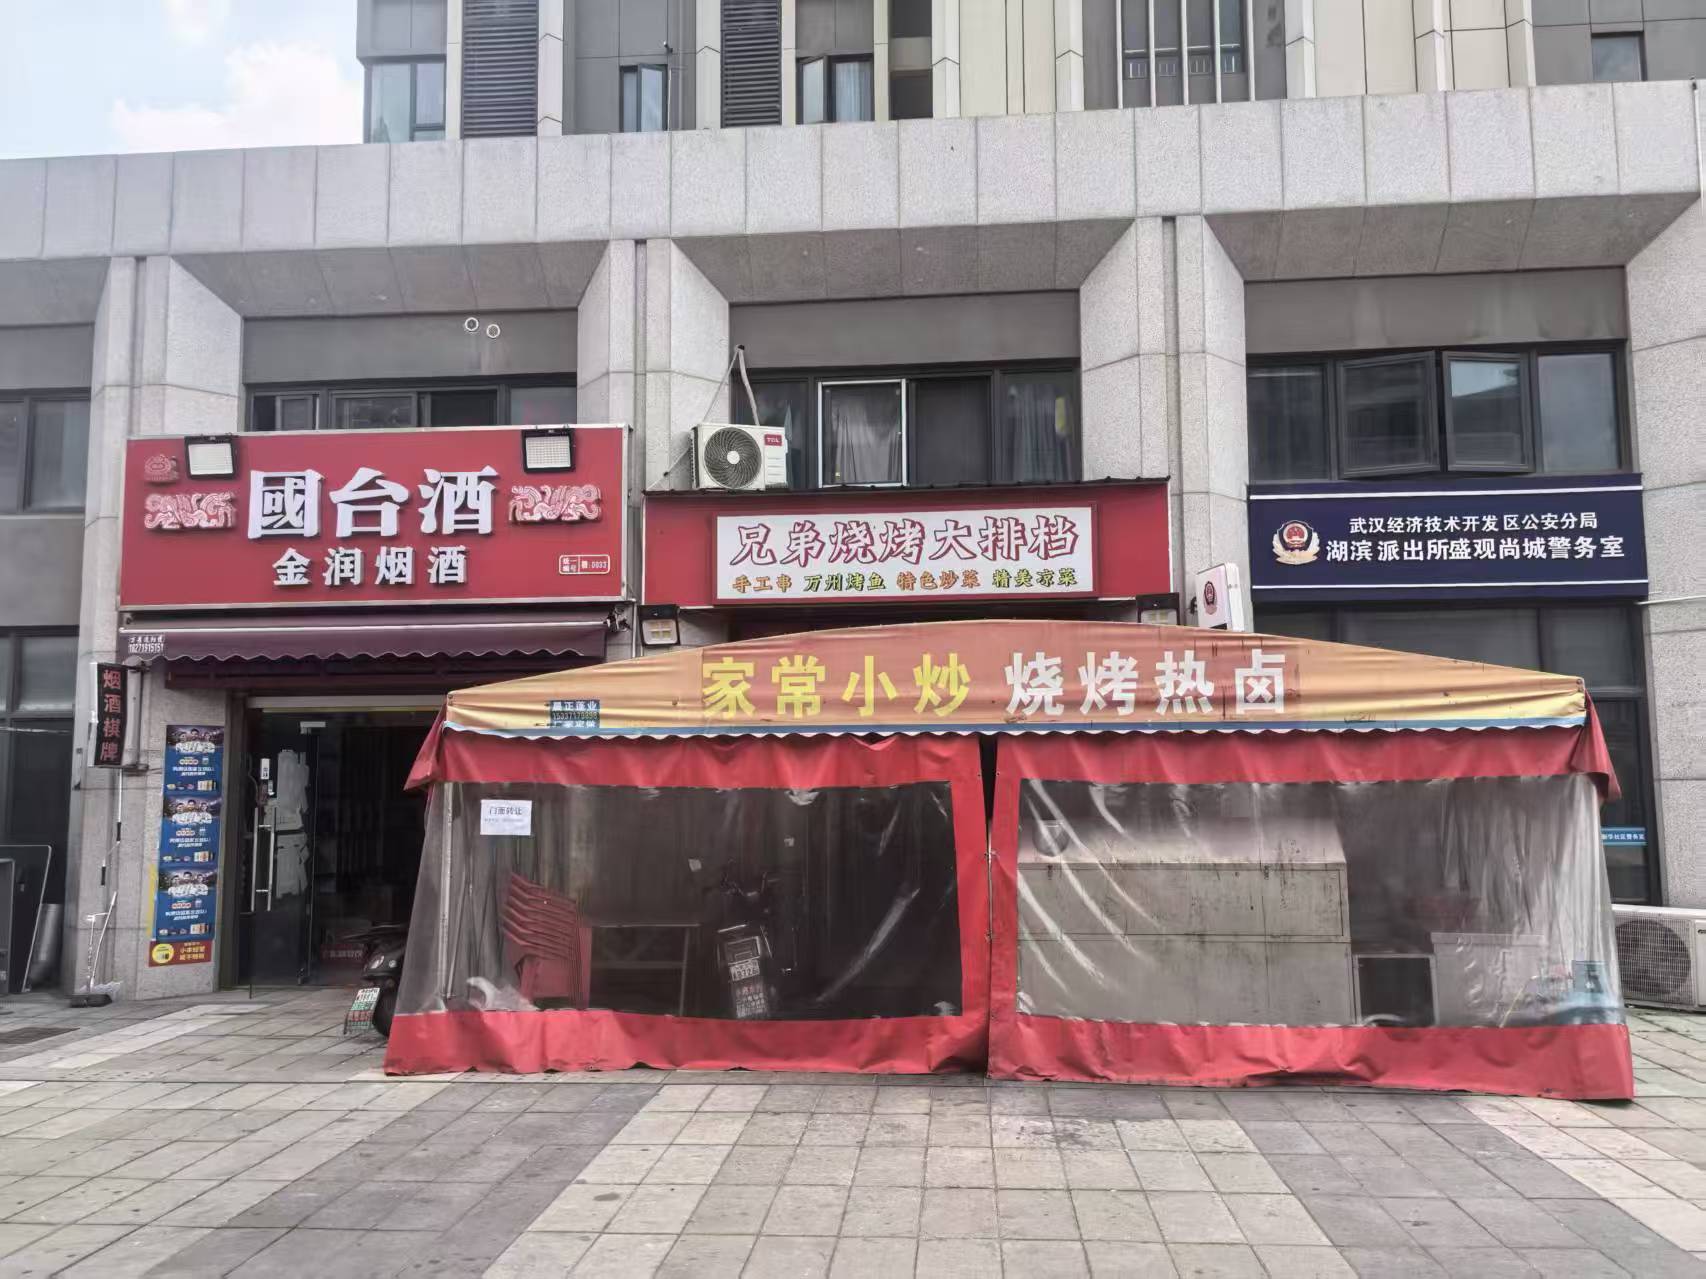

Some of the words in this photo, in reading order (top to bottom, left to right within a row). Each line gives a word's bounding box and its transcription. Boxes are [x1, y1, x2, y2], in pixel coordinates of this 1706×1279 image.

[247, 465, 499, 539] 國台酒
[1349, 511, 1598, 534] 武汉经济技术开发区公安分局
[729, 514, 1080, 567] 兄弟烧烤大排档
[1326, 535, 1625, 562] 湖滨派出所盛观尚城警务室
[272, 544, 469, 586] 金润烟酒
[732, 574, 793, 593] 手工串
[803, 571, 887, 593] 万州烤鱼
[896, 569, 981, 591] 特色炒菜
[991, 567, 1078, 588] 精美凉菜
[701, 653, 971, 720] 家常小炒
[1003, 649, 1286, 716] 烧烤热卤
[99, 669, 122, 761] 烟酒棋牌
[489, 806, 523, 815] 门面转让
